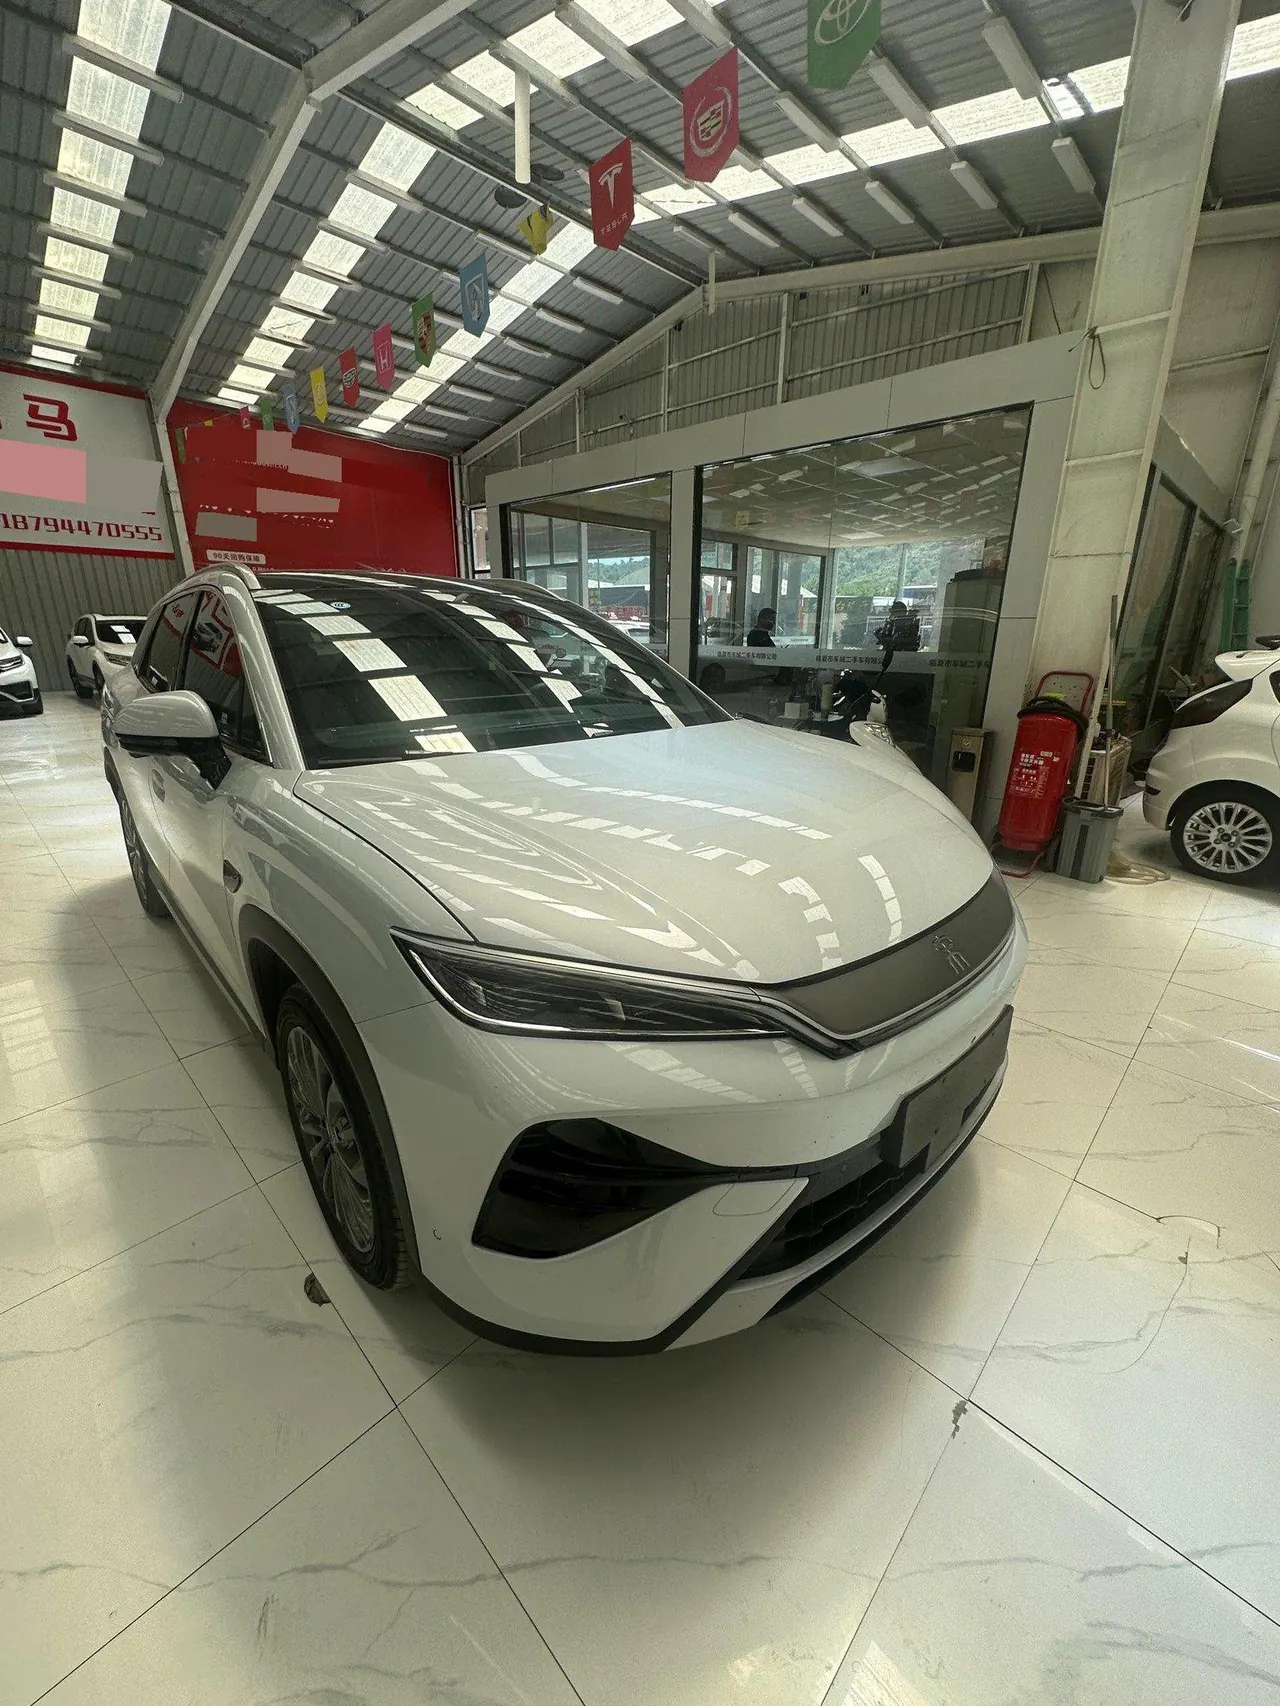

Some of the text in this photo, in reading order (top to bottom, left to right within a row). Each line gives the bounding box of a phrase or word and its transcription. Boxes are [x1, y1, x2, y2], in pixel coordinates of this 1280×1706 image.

[600, 212, 628, 236] TESLA
[0, 512, 162, 541] 18794470555
[815, 655, 884, 665] 临夏市车城二手车有限公
